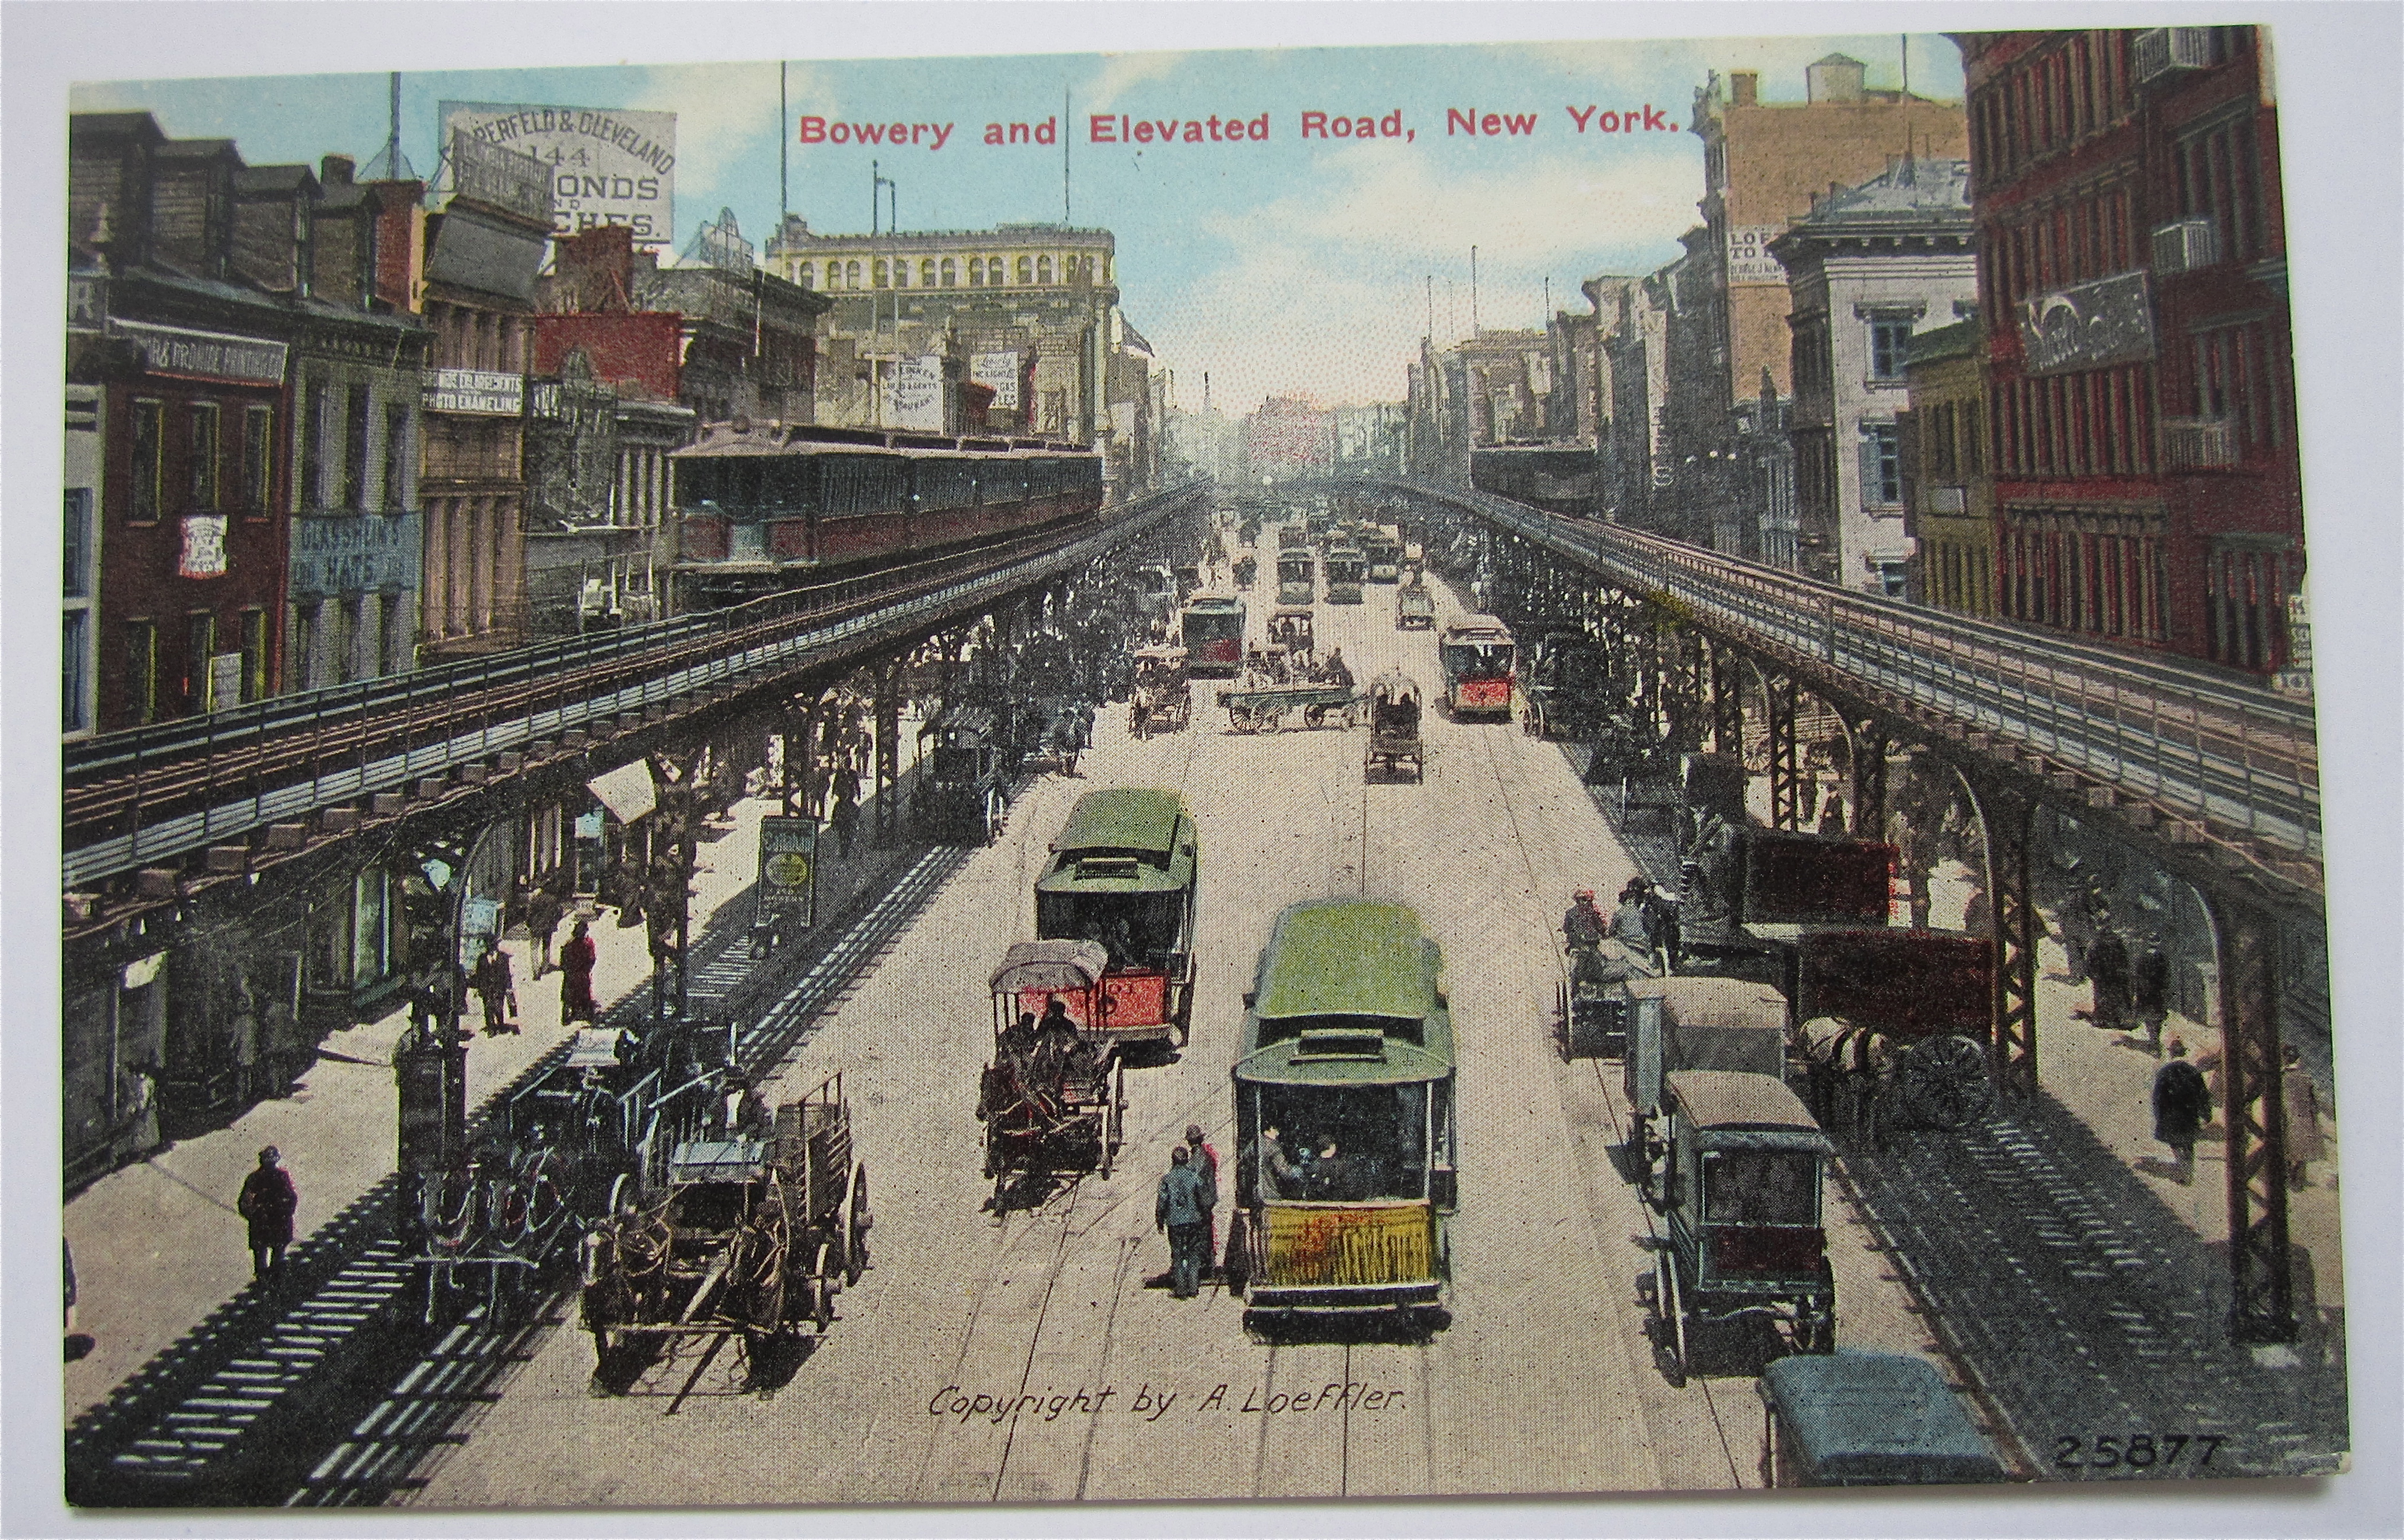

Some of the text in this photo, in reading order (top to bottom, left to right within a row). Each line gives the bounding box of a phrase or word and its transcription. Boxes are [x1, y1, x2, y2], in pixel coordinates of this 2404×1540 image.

[473, 109, 675, 175] PERFELD & CLEVELAND
[557, 174, 659, 200] ONDS
[554, 198, 580, 210] ND
[554, 211, 660, 237] CHES.
